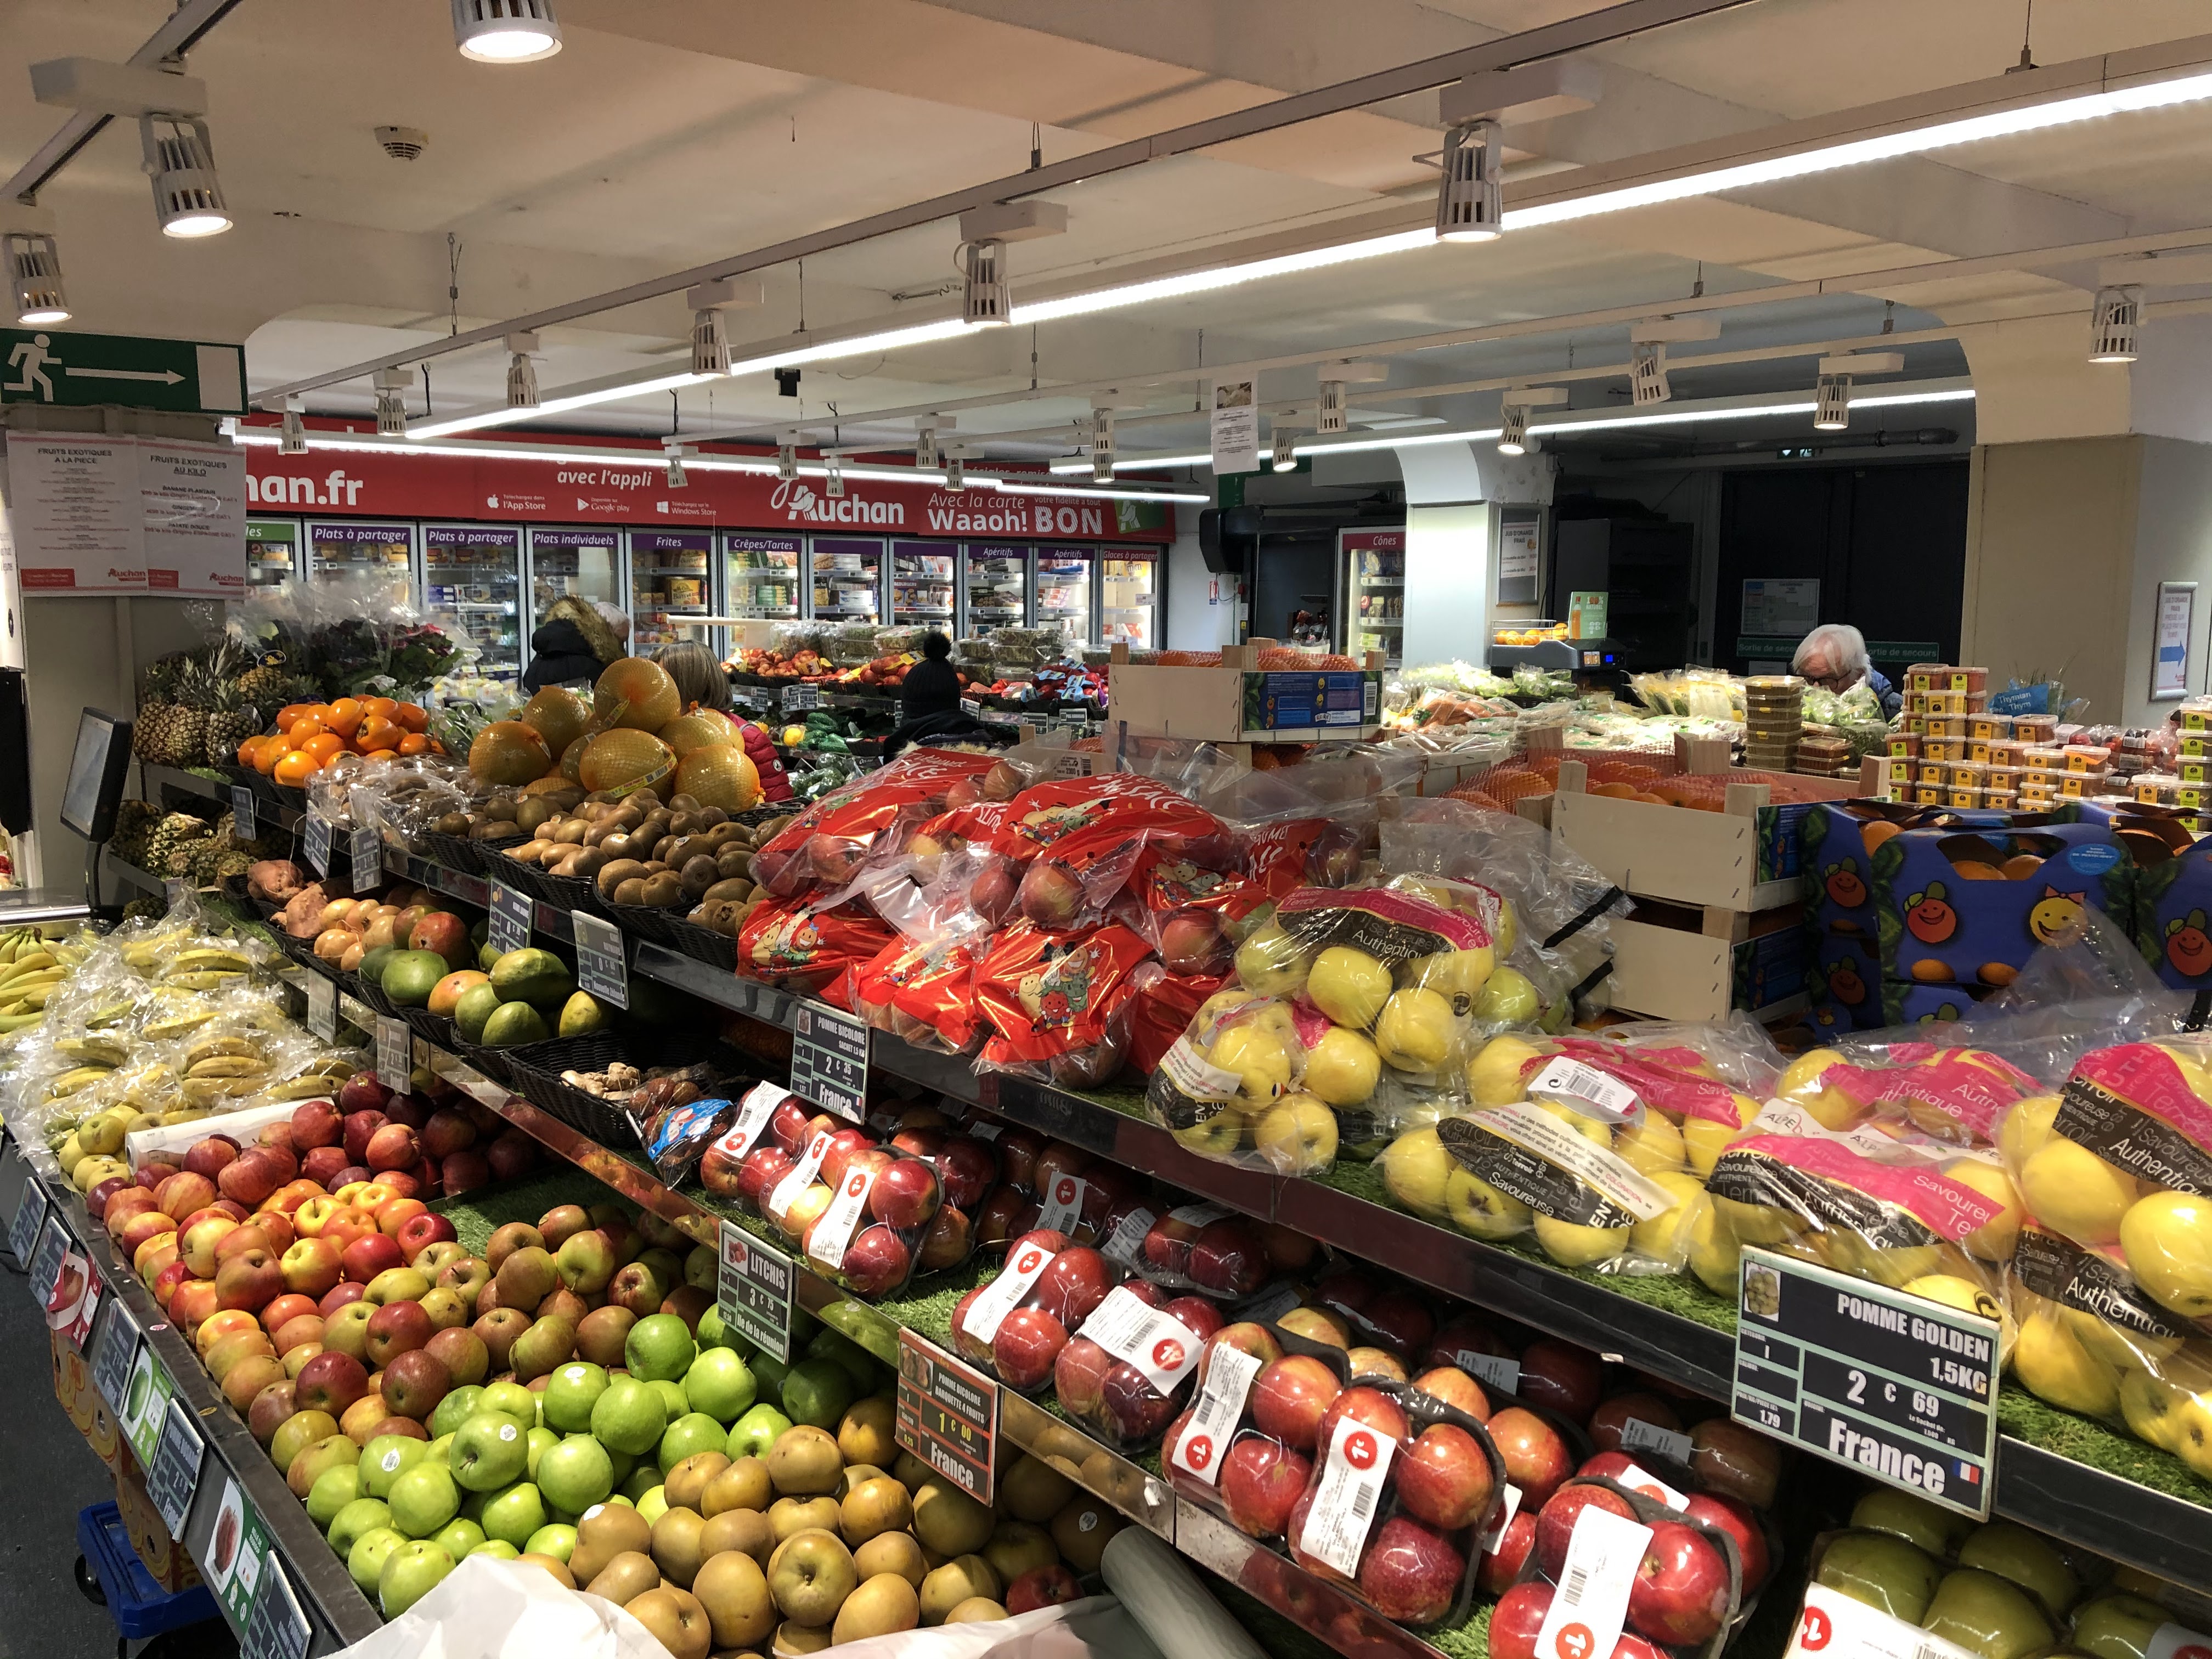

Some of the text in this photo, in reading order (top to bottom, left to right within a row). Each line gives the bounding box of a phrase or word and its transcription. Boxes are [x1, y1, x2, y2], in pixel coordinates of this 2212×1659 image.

[150, 455, 227, 469] FRUITS EXOTIQUES
[557, 469, 652, 490] avec l'appli
[503, 501, 546, 511] l'App Store
[591, 503, 615, 513] Google
[788, 485, 904, 524] Auchan
[928, 493, 1025, 509] Avec la carte
[1034, 496, 1053, 504] votre
[1087, 498, 1101, 506] tout
[927, 508, 1028, 532] Waaoh!
[1035, 506, 1103, 535] BON
[315, 528, 407, 543] Plats à partager
[428, 531, 514, 545] Plats à partager
[534, 533, 614, 545] Plats individuels
[656, 537, 682, 547] Frites
[734, 539, 793, 551] Crêpes/Tartes
[1373, 534, 1397, 546] Cônes
[983, 547, 1013, 558] Apéritifs
[1054, 549, 1082, 560] Apéritifs
[1103, 550, 1124, 559] Glaces
[1130, 552, 1158, 561] partager
[1739, 644, 1762, 652] Sortie
[1867, 647, 1882, 656] ortie
[1998, 691, 2032, 705] Thymian
[2008, 701, 2032, 711] Thym
[1352, 930, 1424, 960] Authentiq
[818, 1016, 865, 1045] POMME BICOLORE
[839, 1040, 853, 1053] SACHET
[825, 1056, 851, 1075] 2 € 35
[819, 1083, 851, 1111] France
[2109, 1138, 2202, 1196] Authentiq
[2139, 1127, 2212, 1187] Savoureus
[1493, 1162, 1548, 1197] AUTHENTIQUE
[1489, 1171, 1555, 1217] Savoureuse
[1914, 1175, 1990, 1223] Savoure
[751, 1252, 786, 1290] LITCHIS
[749, 1288, 774, 1312] 3 € 75
[2066, 1276, 2175, 1338] Authentiq
[745, 1319, 753, 1333] de
[754, 1324, 759, 1338] la
[760, 1327, 784, 1356] réunion
[1837, 1293, 1990, 1363] POMME GOLDEN
[938, 1372, 981, 1407] POMME BICOLORE
[1847, 1369, 1939, 1418] 2 € 69
[935, 1385, 985, 1425] BARQUETTE 4 FRUITS
[939, 1412, 972, 1442] 1 € 00
[931, 1441, 974, 1490] France
[1829, 1418, 1946, 1496] France
